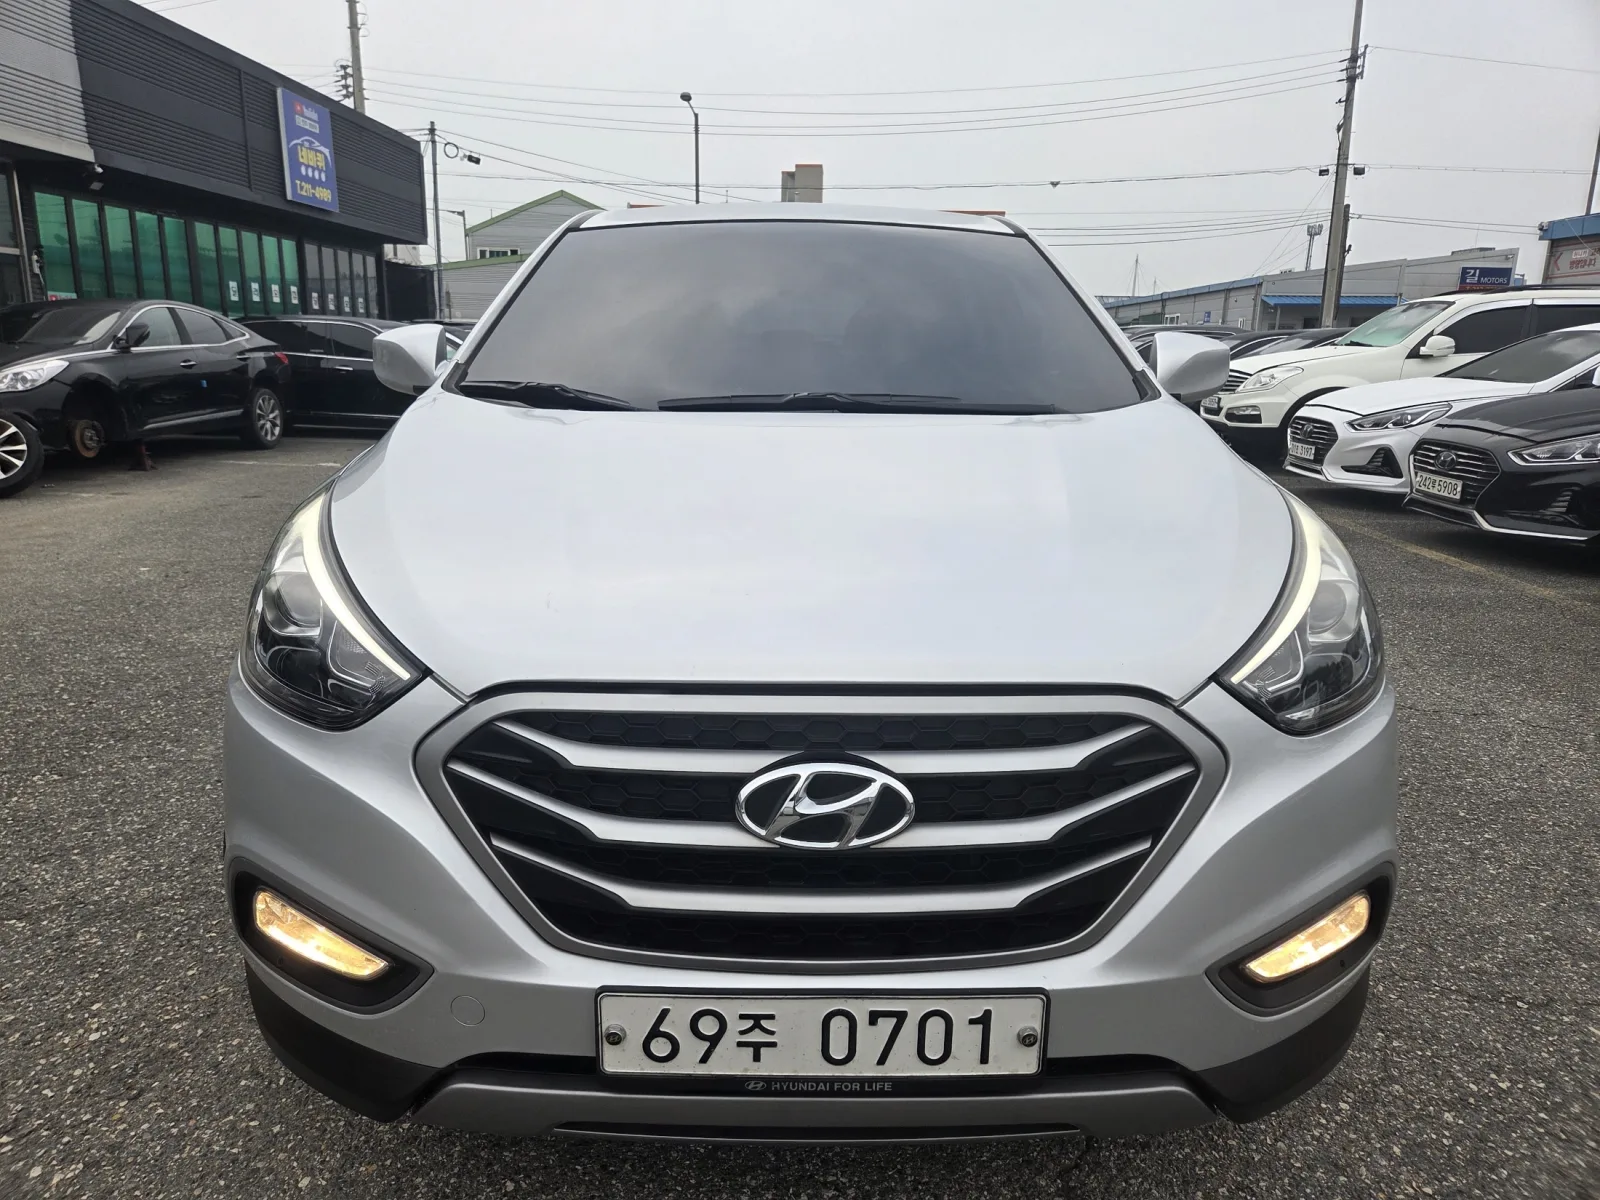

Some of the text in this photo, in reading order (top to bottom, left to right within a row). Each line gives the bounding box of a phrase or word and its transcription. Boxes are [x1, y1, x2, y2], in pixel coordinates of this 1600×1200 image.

[1465, 269, 1480, 284] 길
[1300, 445, 1313, 458] 3197
[1437, 479, 1458, 496] 5908
[642, 1007, 994, 1066] 69주 0701
[771, 1081, 893, 1092] HYUNDAI FOR LIFE
